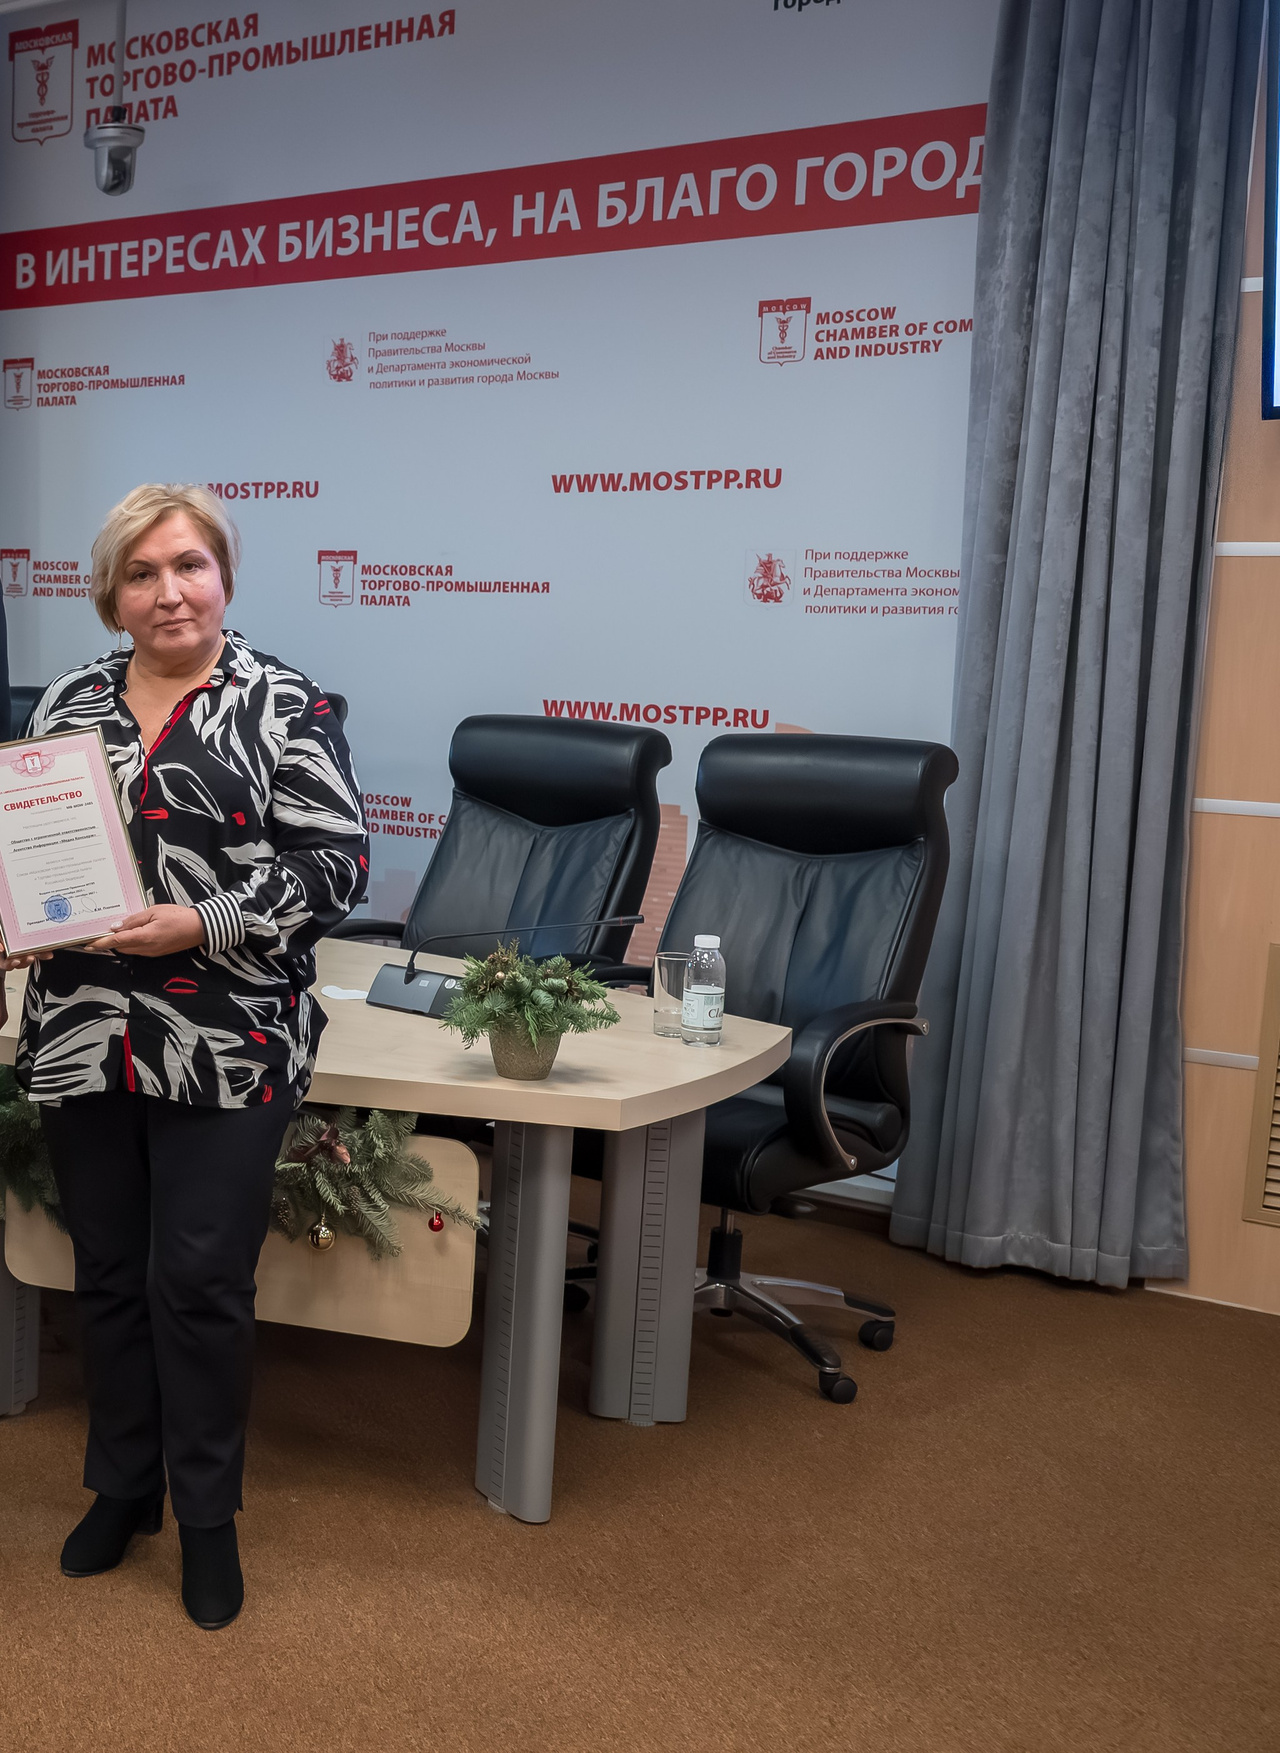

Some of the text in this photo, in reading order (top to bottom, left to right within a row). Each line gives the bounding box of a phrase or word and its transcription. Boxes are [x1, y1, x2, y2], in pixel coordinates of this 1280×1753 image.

[15, 253, 36, 290] В
[46, 225, 266, 287] ИНТЕРЕСАХ
[278, 200, 498, 263] БИЗНЕСА,
[511, 188, 581, 238] НА
[596, 163, 778, 229] БЛАГО
[762, 303, 808, 312] MOSCOW
[815, 306, 897, 326] MOSCOW
[368, 328, 447, 344] При поддержке
[814, 324, 900, 343] CHAMBER
[904, 321, 928, 337] OF
[367, 341, 486, 359] Правительства Москвы
[813, 338, 943, 361] AND INDUSTRY
[367, 353, 532, 376] и Департамента экономической
[36, 365, 110, 380] МОСКОВСКАЯ
[369, 370, 560, 390] политики и развития города Москвы
[36, 374, 185, 394] ТОРГОВО-ПРОМЫШЛЕННАЯ
[36, 395, 77, 407] ПАЛАТА
[551, 468, 783, 493] WWW.MOSTPP.RU
[193, 481, 319, 500] MOSTPP.RU
[804, 549, 909, 563] При поддержке
[32, 561, 79, 571] MOSCOW
[360, 564, 453, 577] МОСКОВСКАЯ
[804, 566, 960, 580] Правительства Москвы
[32, 574, 81, 585] CHAMBER
[360, 580, 550, 594] ТОРГОВО-ПРОМЫШЛЕННАЯ
[32, 587, 54, 597] AND
[803, 587, 811, 596] и
[813, 584, 908, 599] Департамента
[360, 595, 411, 607] ПАЛАТА
[805, 605, 867, 614] политики
[870, 605, 879, 614] и
[882, 605, 944, 617] развития
[542, 699, 770, 729] WWW.MOSTPP.RU
[4, 790, 83, 812] СВИДЕТЕЛЬСТВО
[418, 812, 436, 824] OF
